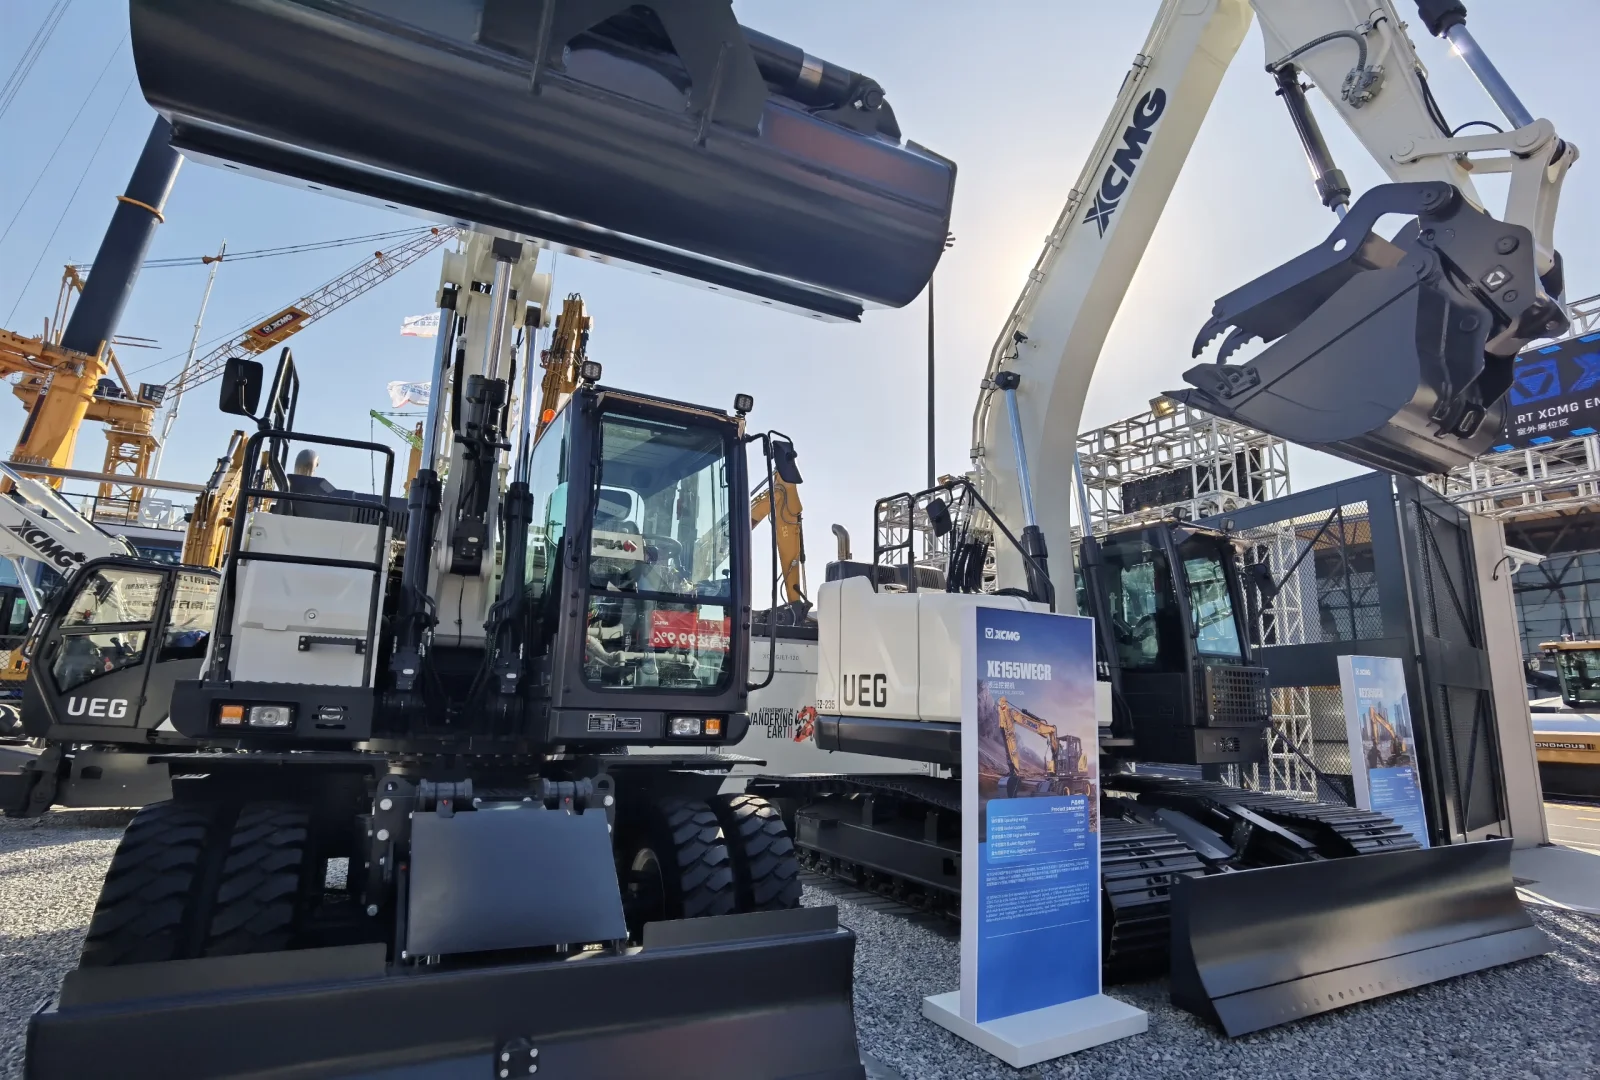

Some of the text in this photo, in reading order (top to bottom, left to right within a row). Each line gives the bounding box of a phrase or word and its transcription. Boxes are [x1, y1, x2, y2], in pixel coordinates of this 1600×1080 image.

[1082, 88, 1167, 239] XCMG
[271, 314, 293, 328] XCMG
[1514, 412, 1534, 426] RT
[1538, 399, 1580, 419] XCMG
[1516, 418, 1570, 437] 室外展位区
[6, 518, 76, 567] XCMG
[993, 630, 1021, 642] XCMG
[986, 660, 1052, 681] XE155WECR
[843, 673, 888, 708] UEG
[67, 696, 128, 718] UEG
